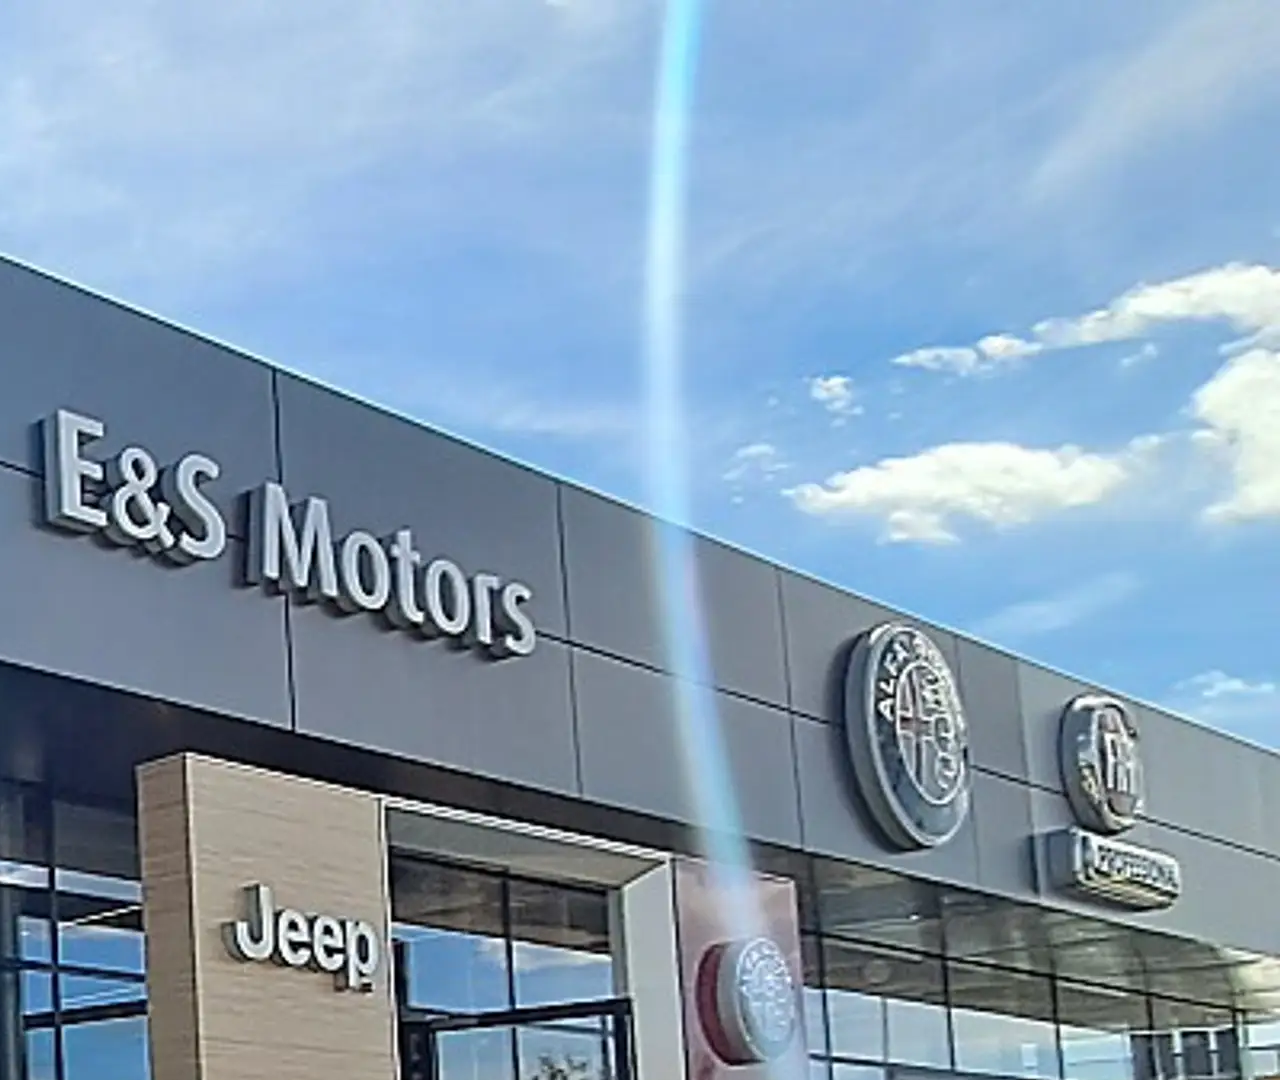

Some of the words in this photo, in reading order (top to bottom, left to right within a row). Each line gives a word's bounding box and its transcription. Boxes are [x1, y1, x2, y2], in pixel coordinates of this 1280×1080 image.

[52, 408, 227, 563] E&S
[260, 481, 537, 658] Motors
[233, 882, 379, 990] Jeep
